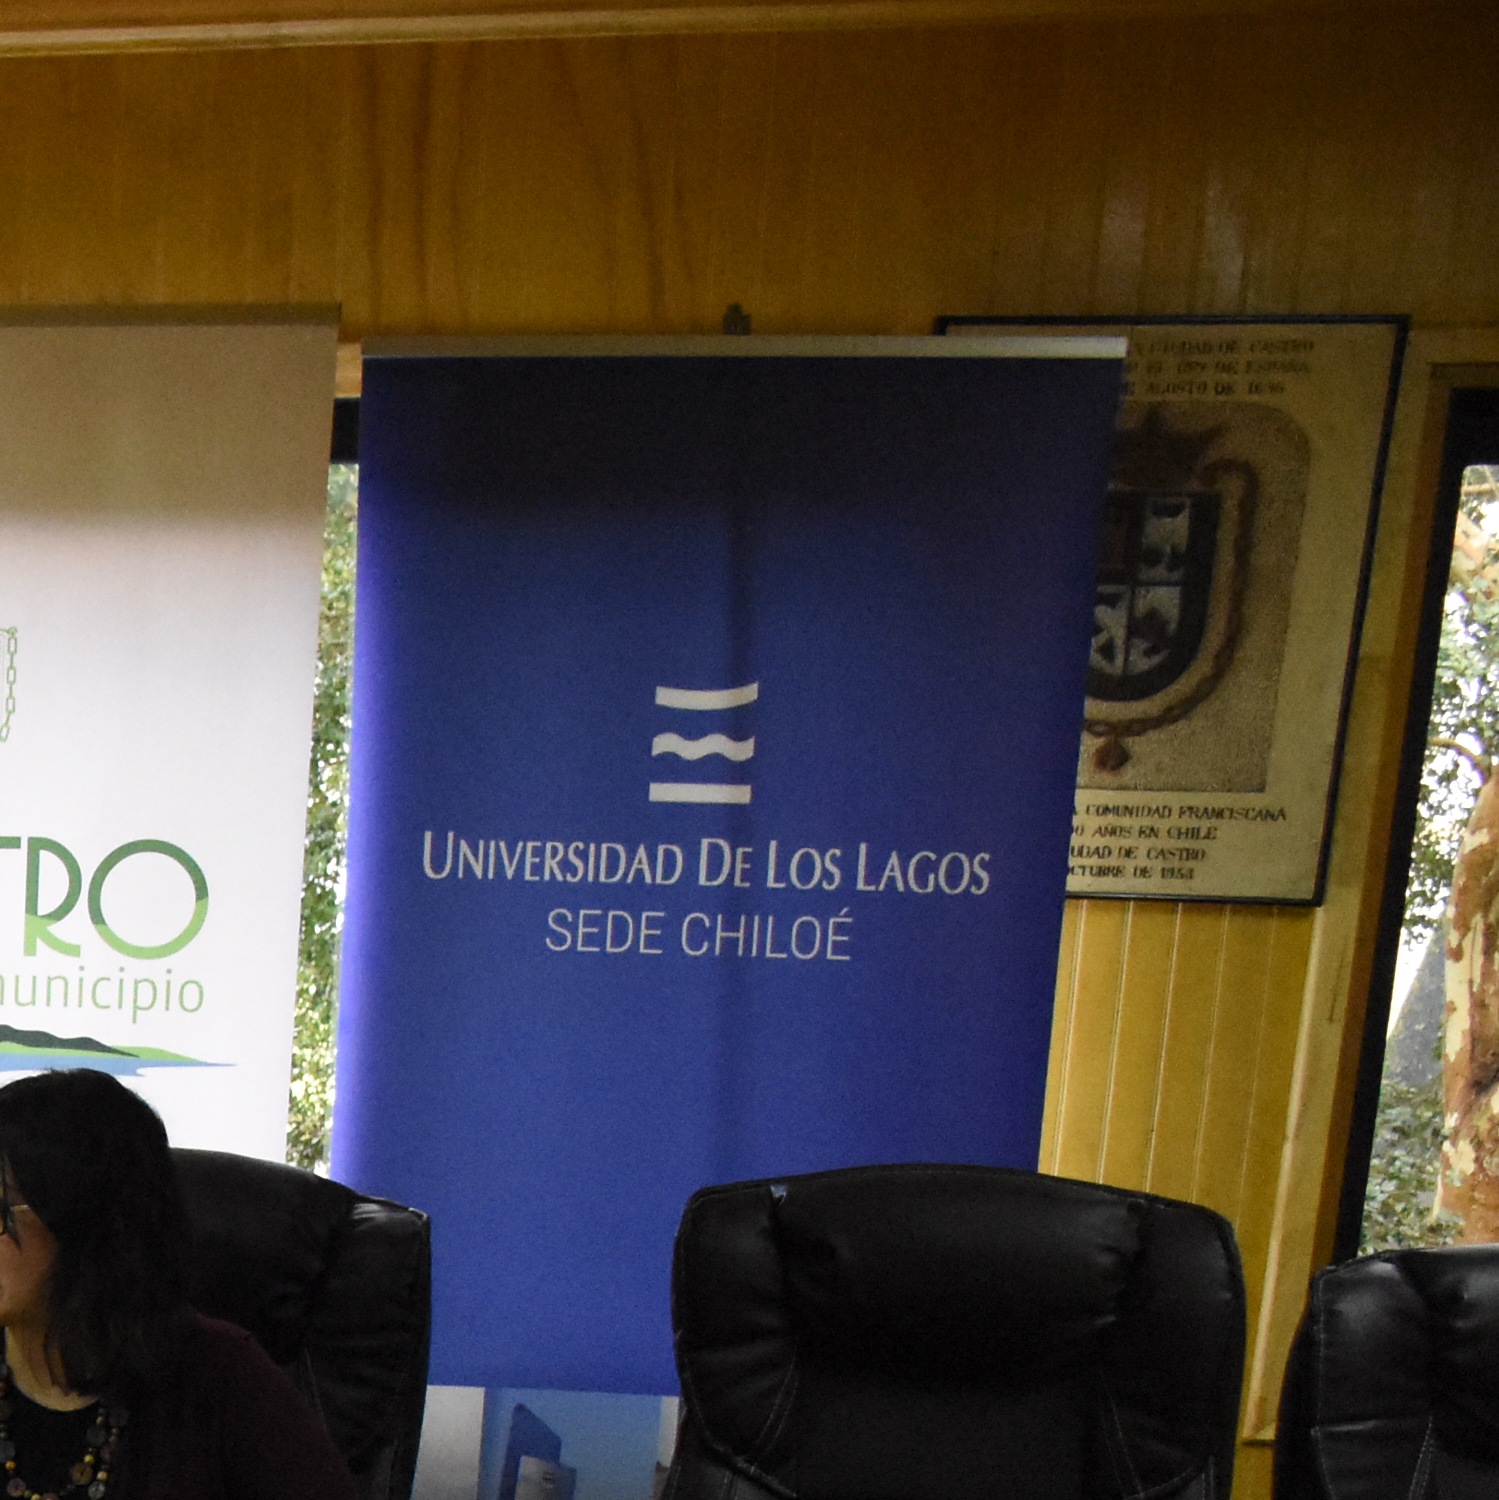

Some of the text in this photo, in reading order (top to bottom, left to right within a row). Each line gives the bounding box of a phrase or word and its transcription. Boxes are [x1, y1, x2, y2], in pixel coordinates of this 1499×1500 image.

[1085, 803, 1287, 823] COMUNIDAD FRANCISCANA
[1138, 825, 1160, 839] EN
[1166, 825, 1218, 841] CHILE
[422, 830, 684, 886] UNIVERSIDAD
[766, 840, 842, 891] LOS
[855, 842, 992, 895] LAGOS
[1070, 845, 1206, 862] UDAD DE CASTRO
[1068, 864, 1125, 878] CTUBRE
[1133, 865, 1153, 878] DE
[545, 907, 855, 961] SEDE CHILOÉ
